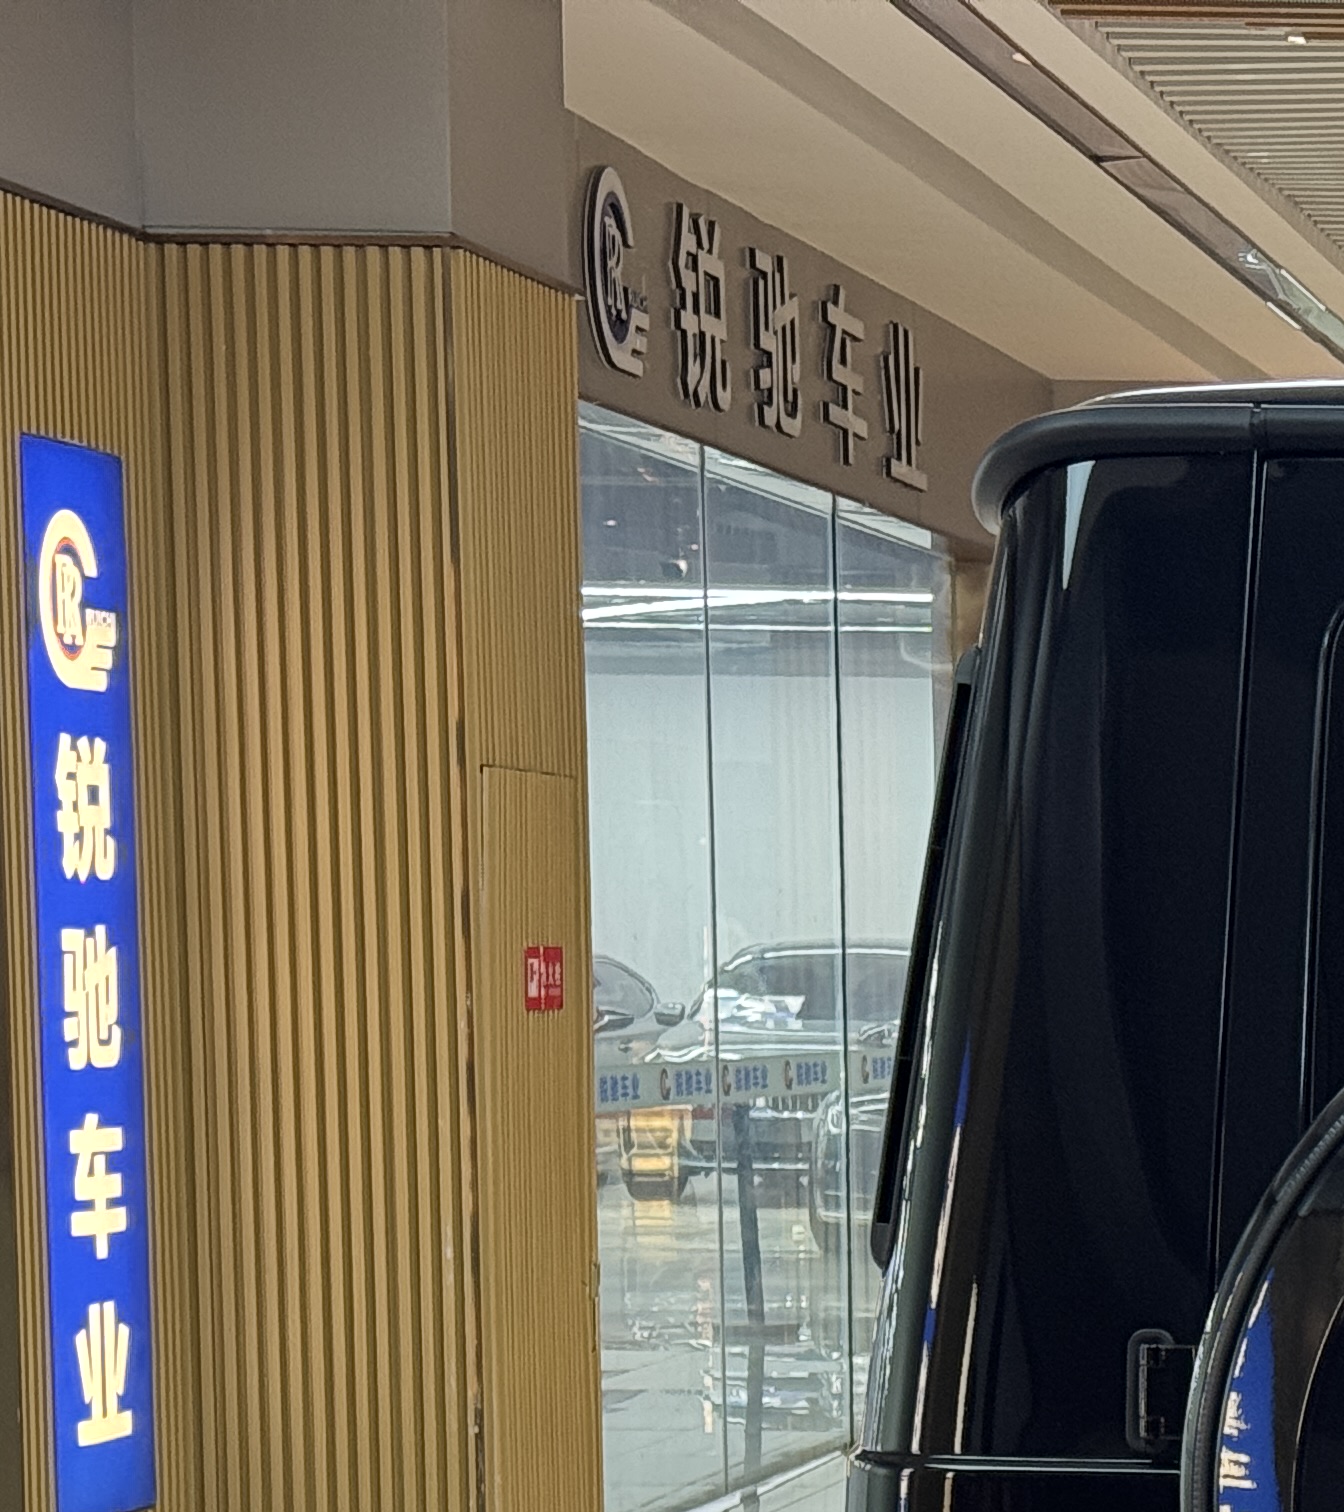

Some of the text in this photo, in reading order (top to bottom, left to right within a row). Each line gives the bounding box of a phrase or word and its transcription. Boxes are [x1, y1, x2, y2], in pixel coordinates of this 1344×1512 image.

[669, 202, 927, 492] 锐驰车业
[55, 732, 133, 1447] 锐驰车业
